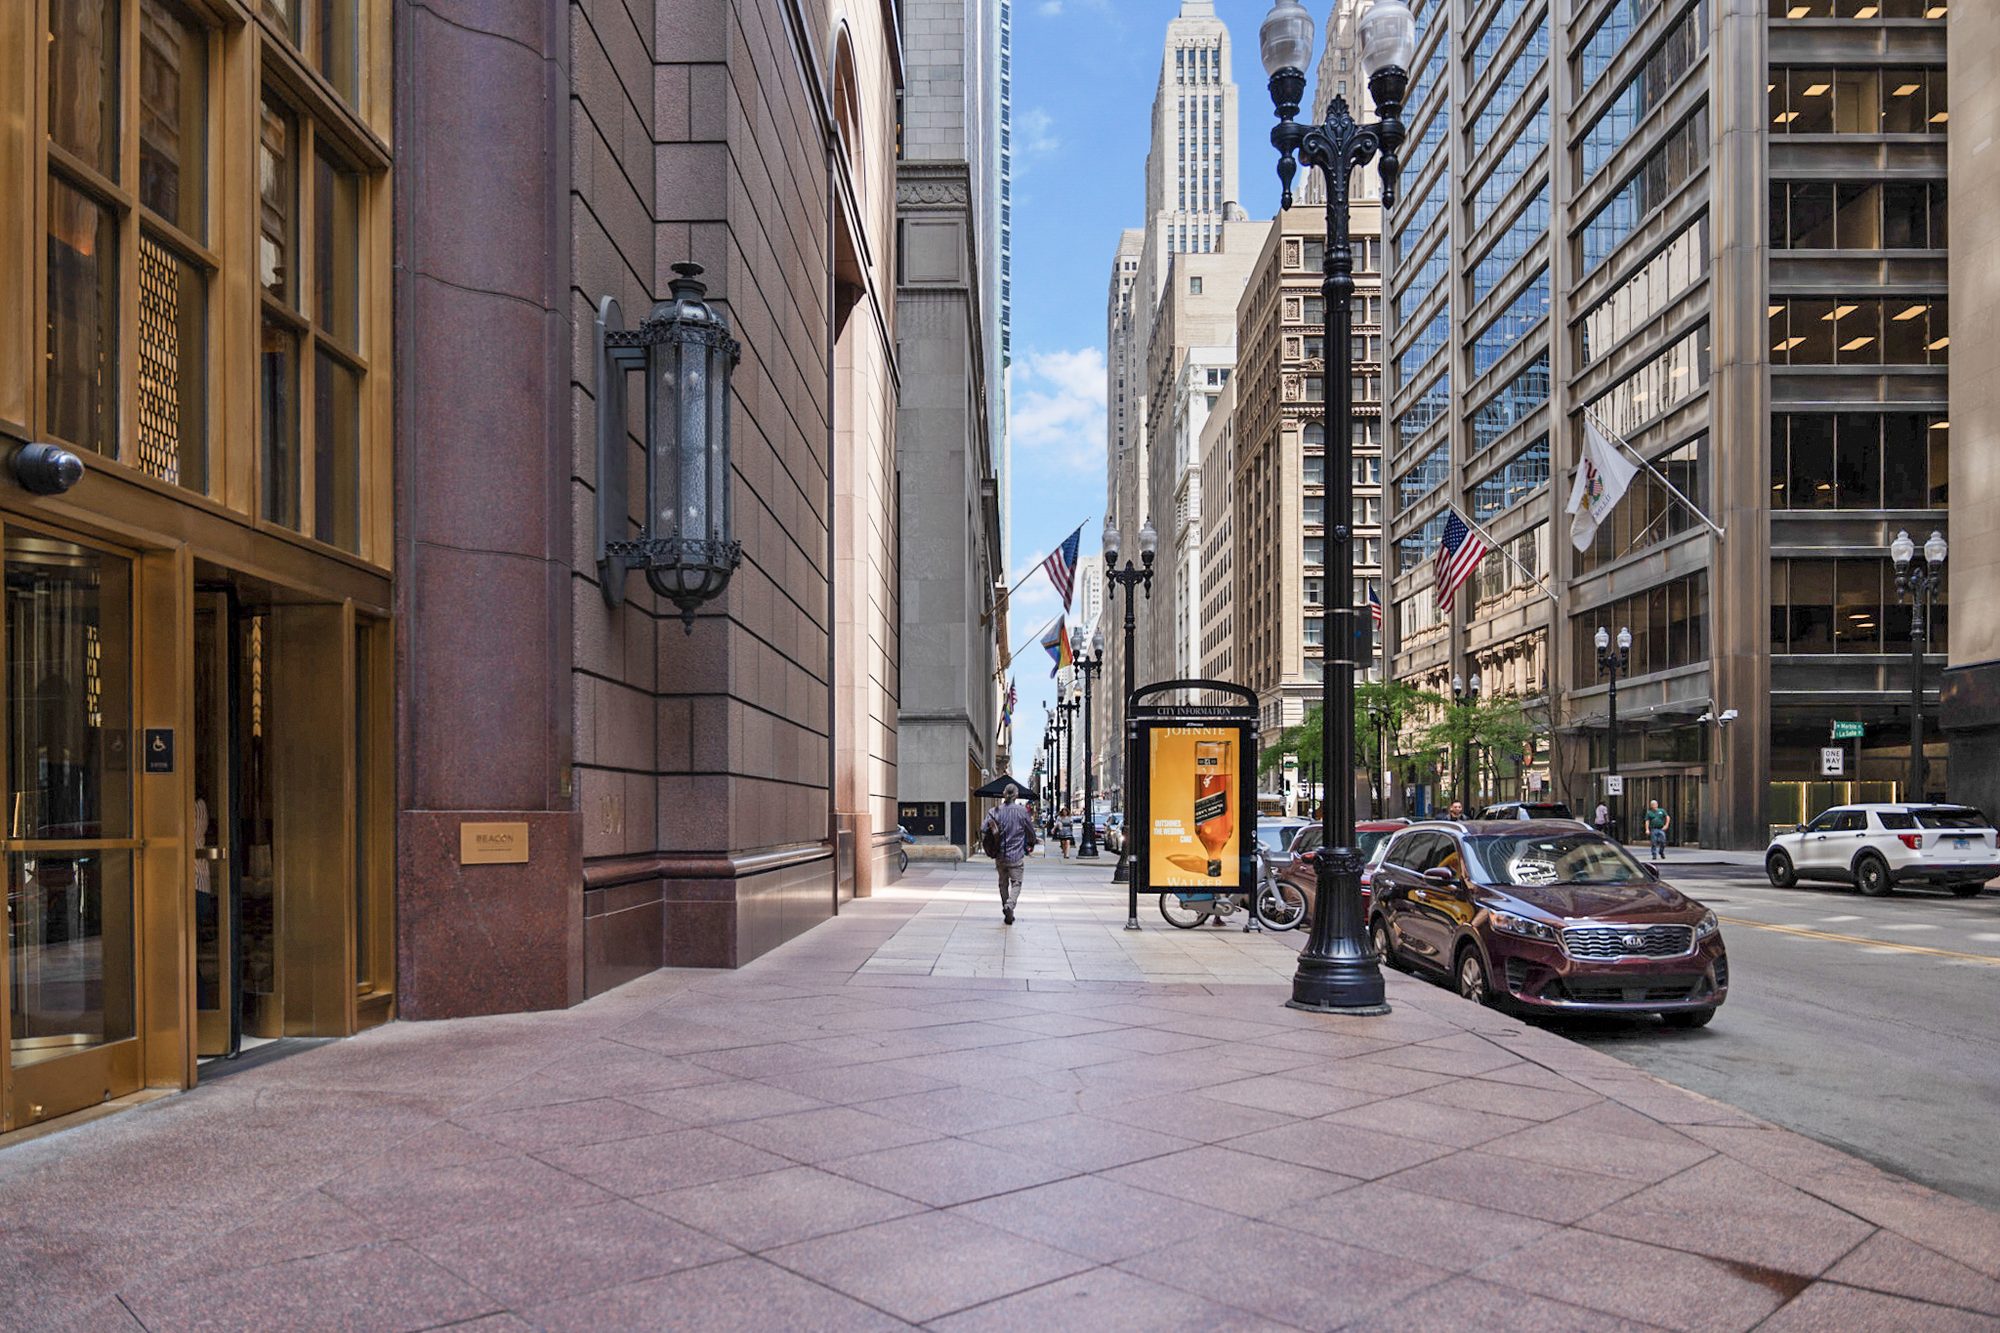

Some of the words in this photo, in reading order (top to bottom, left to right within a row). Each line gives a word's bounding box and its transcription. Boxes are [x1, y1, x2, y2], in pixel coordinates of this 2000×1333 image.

[1157, 707, 1175, 715] CITY
[1177, 707, 1231, 715] INFORMATION
[1165, 728, 1225, 737] JOHNNIE
[476, 834, 514, 843] BEACON
[1626, 938, 1642, 946] KIA
